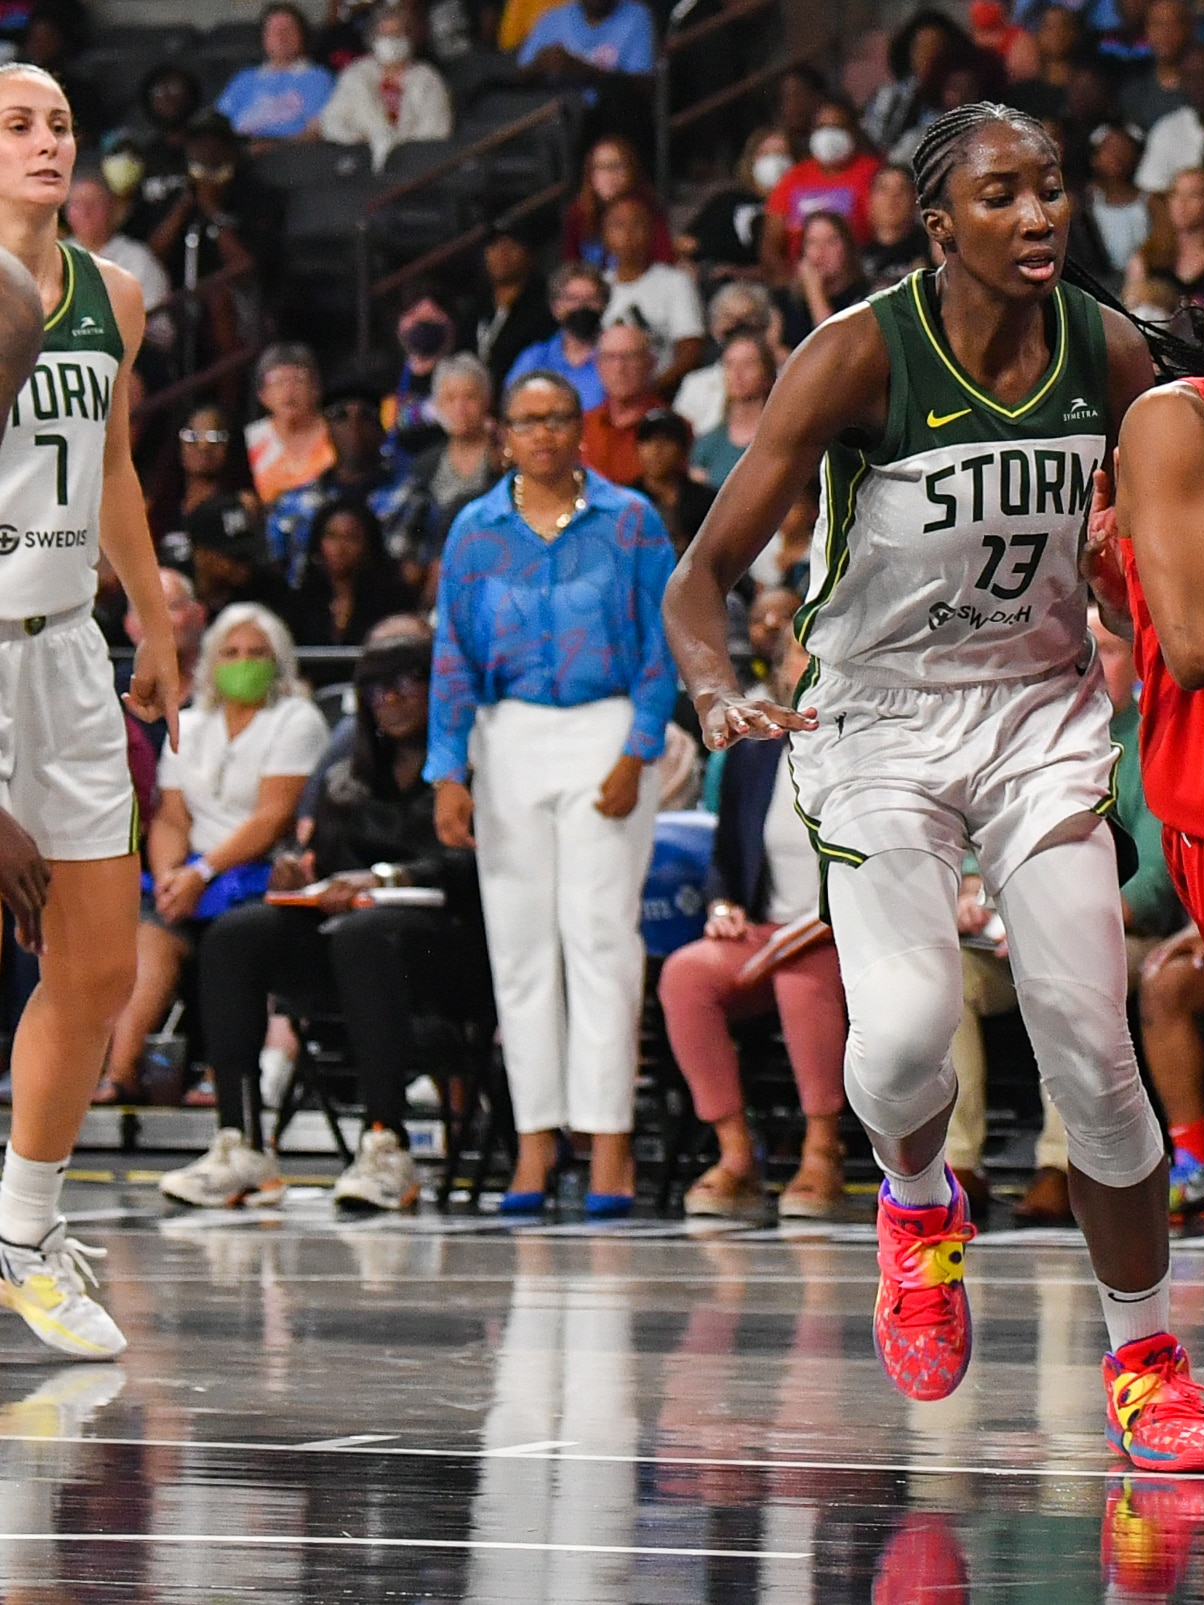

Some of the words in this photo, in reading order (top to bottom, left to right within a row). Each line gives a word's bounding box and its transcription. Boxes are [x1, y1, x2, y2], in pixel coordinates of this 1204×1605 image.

[1063, 410, 1099, 421] SYMETRA
[35, 435, 68, 506] 7
[923, 450, 1098, 533] STORM
[974, 533, 1049, 601] 13
